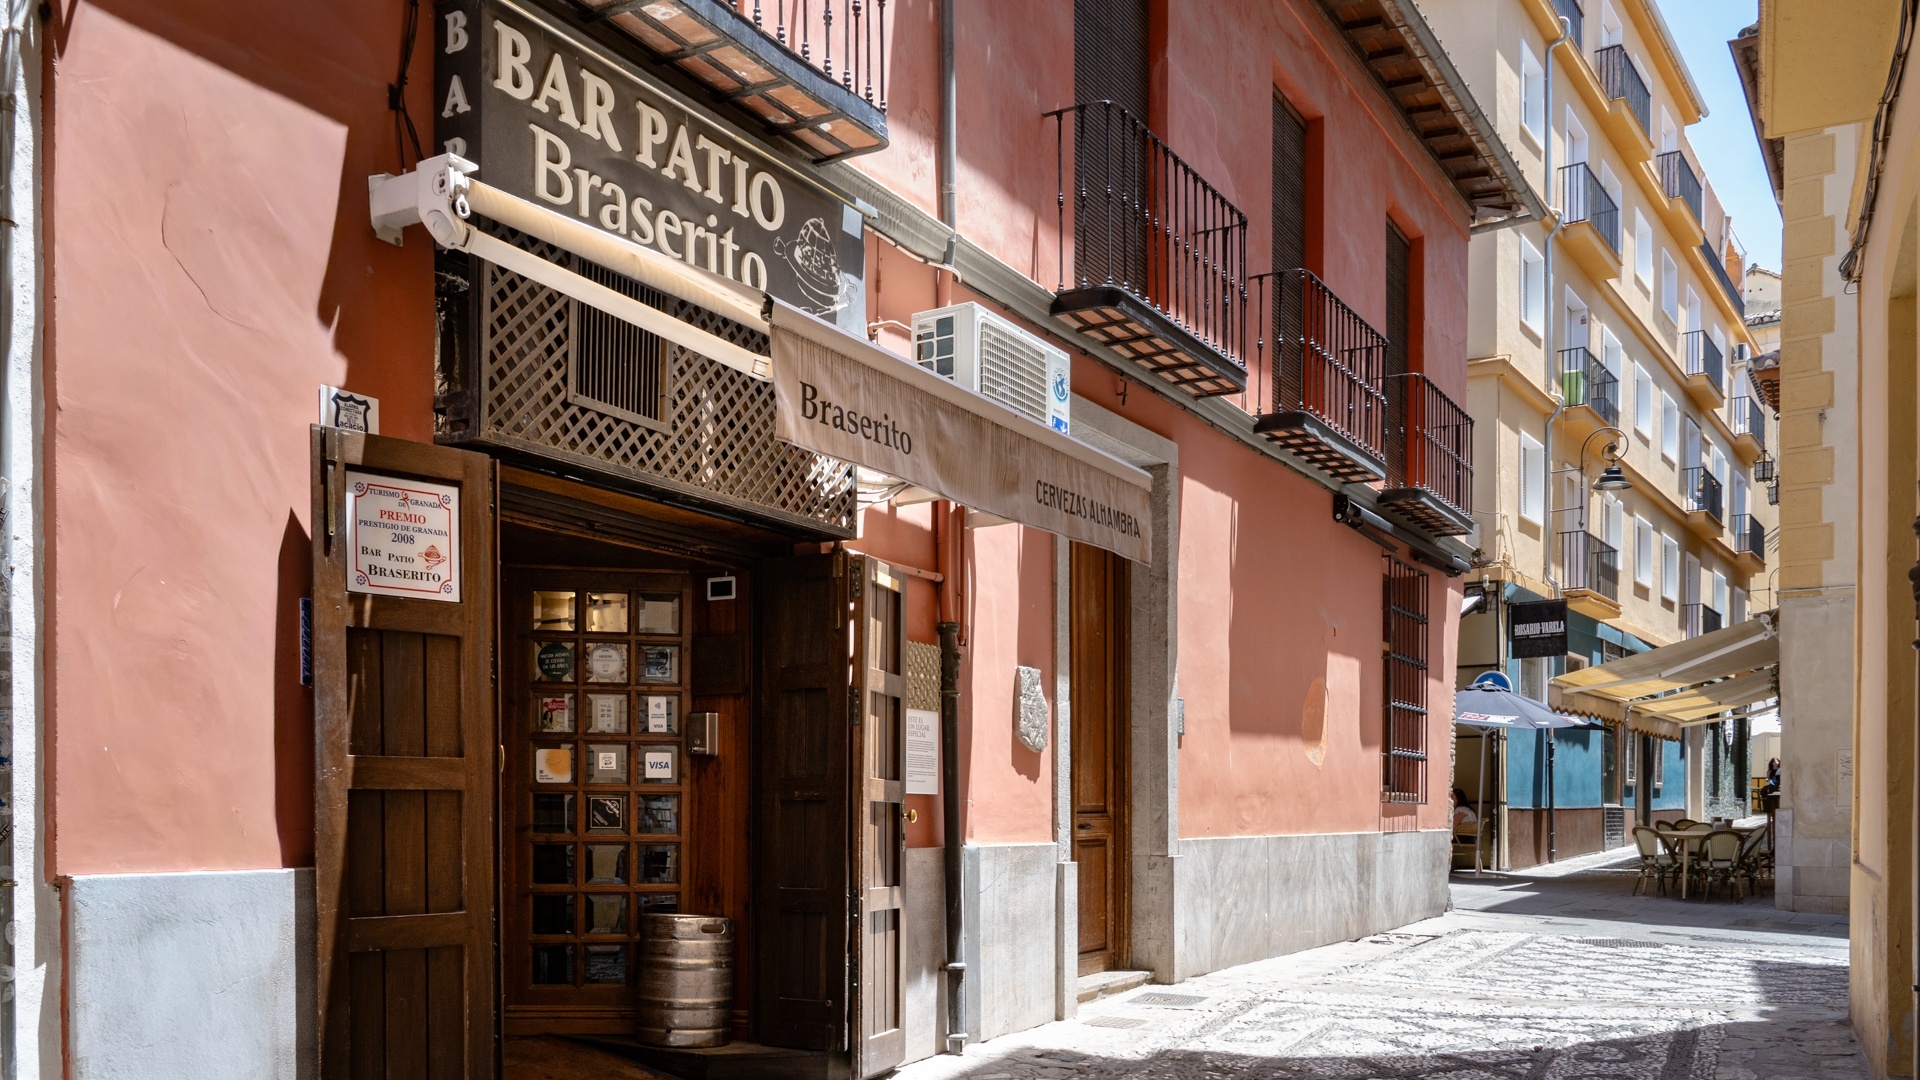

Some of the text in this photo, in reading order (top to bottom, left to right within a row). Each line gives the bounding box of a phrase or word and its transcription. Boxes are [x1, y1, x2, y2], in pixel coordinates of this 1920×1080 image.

[494, 19, 785, 231] BAR PATIO
[529, 124, 767, 291] Braserito
[800, 381, 912, 455] Braserito
[369, 488, 400, 498] TURISMO
[410, 499, 442, 509] GRANADA
[380, 509, 426, 524] PREMIO
[1036, 480, 1141, 539] CERVEZAS ALHAMBRA
[358, 519, 399, 530] PRESTIGIO
[412, 526, 448, 537] GRANADA
[391, 532, 415, 545] 2008
[908, 730, 926, 738] ESPECIAL
[915, 724, 930, 732] LUGAR
[649, 761, 670, 770] VISA
